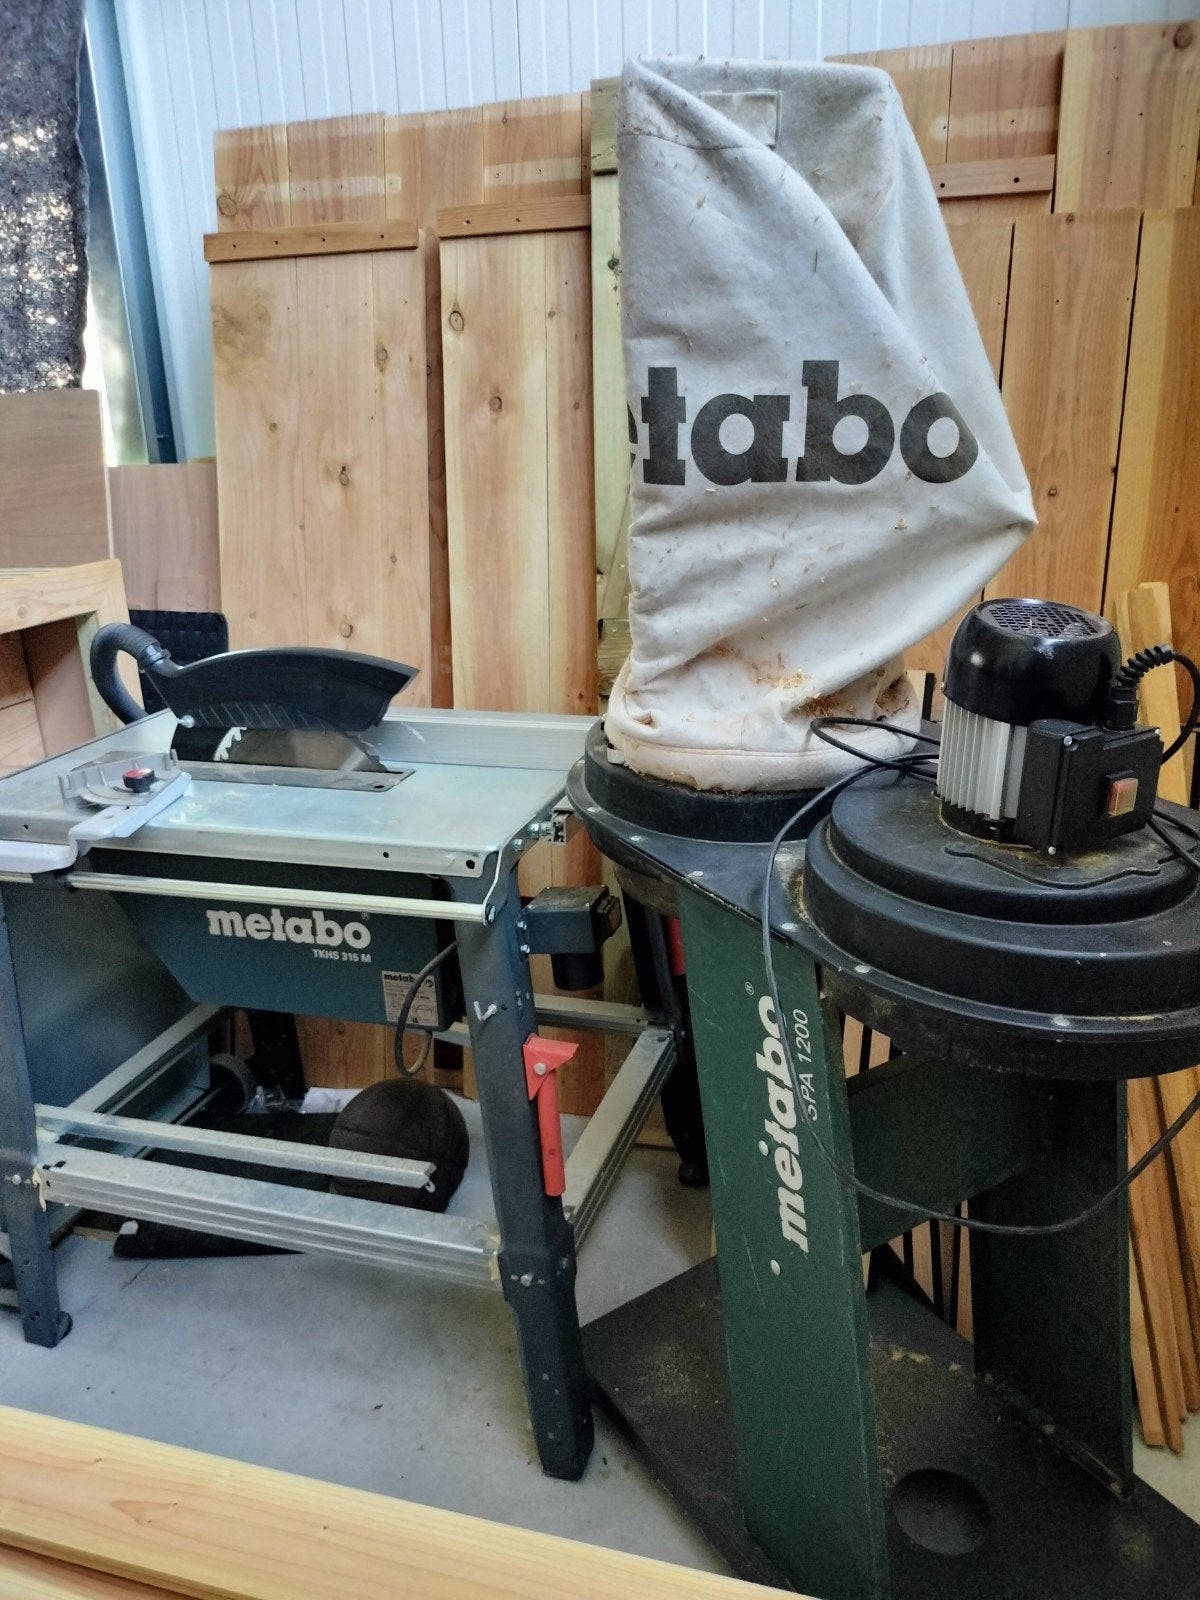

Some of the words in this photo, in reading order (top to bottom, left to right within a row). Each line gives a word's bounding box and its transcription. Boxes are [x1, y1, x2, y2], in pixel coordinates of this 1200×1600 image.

[206, 908, 371, 949] metabo
[312, 949, 340, 960] TKHS
[341, 952, 359, 962] 315
[361, 953, 372, 963] M
[384, 974, 416, 983] metab
[793, 1009, 812, 1063] 1200
[756, 996, 808, 1253] metabo
